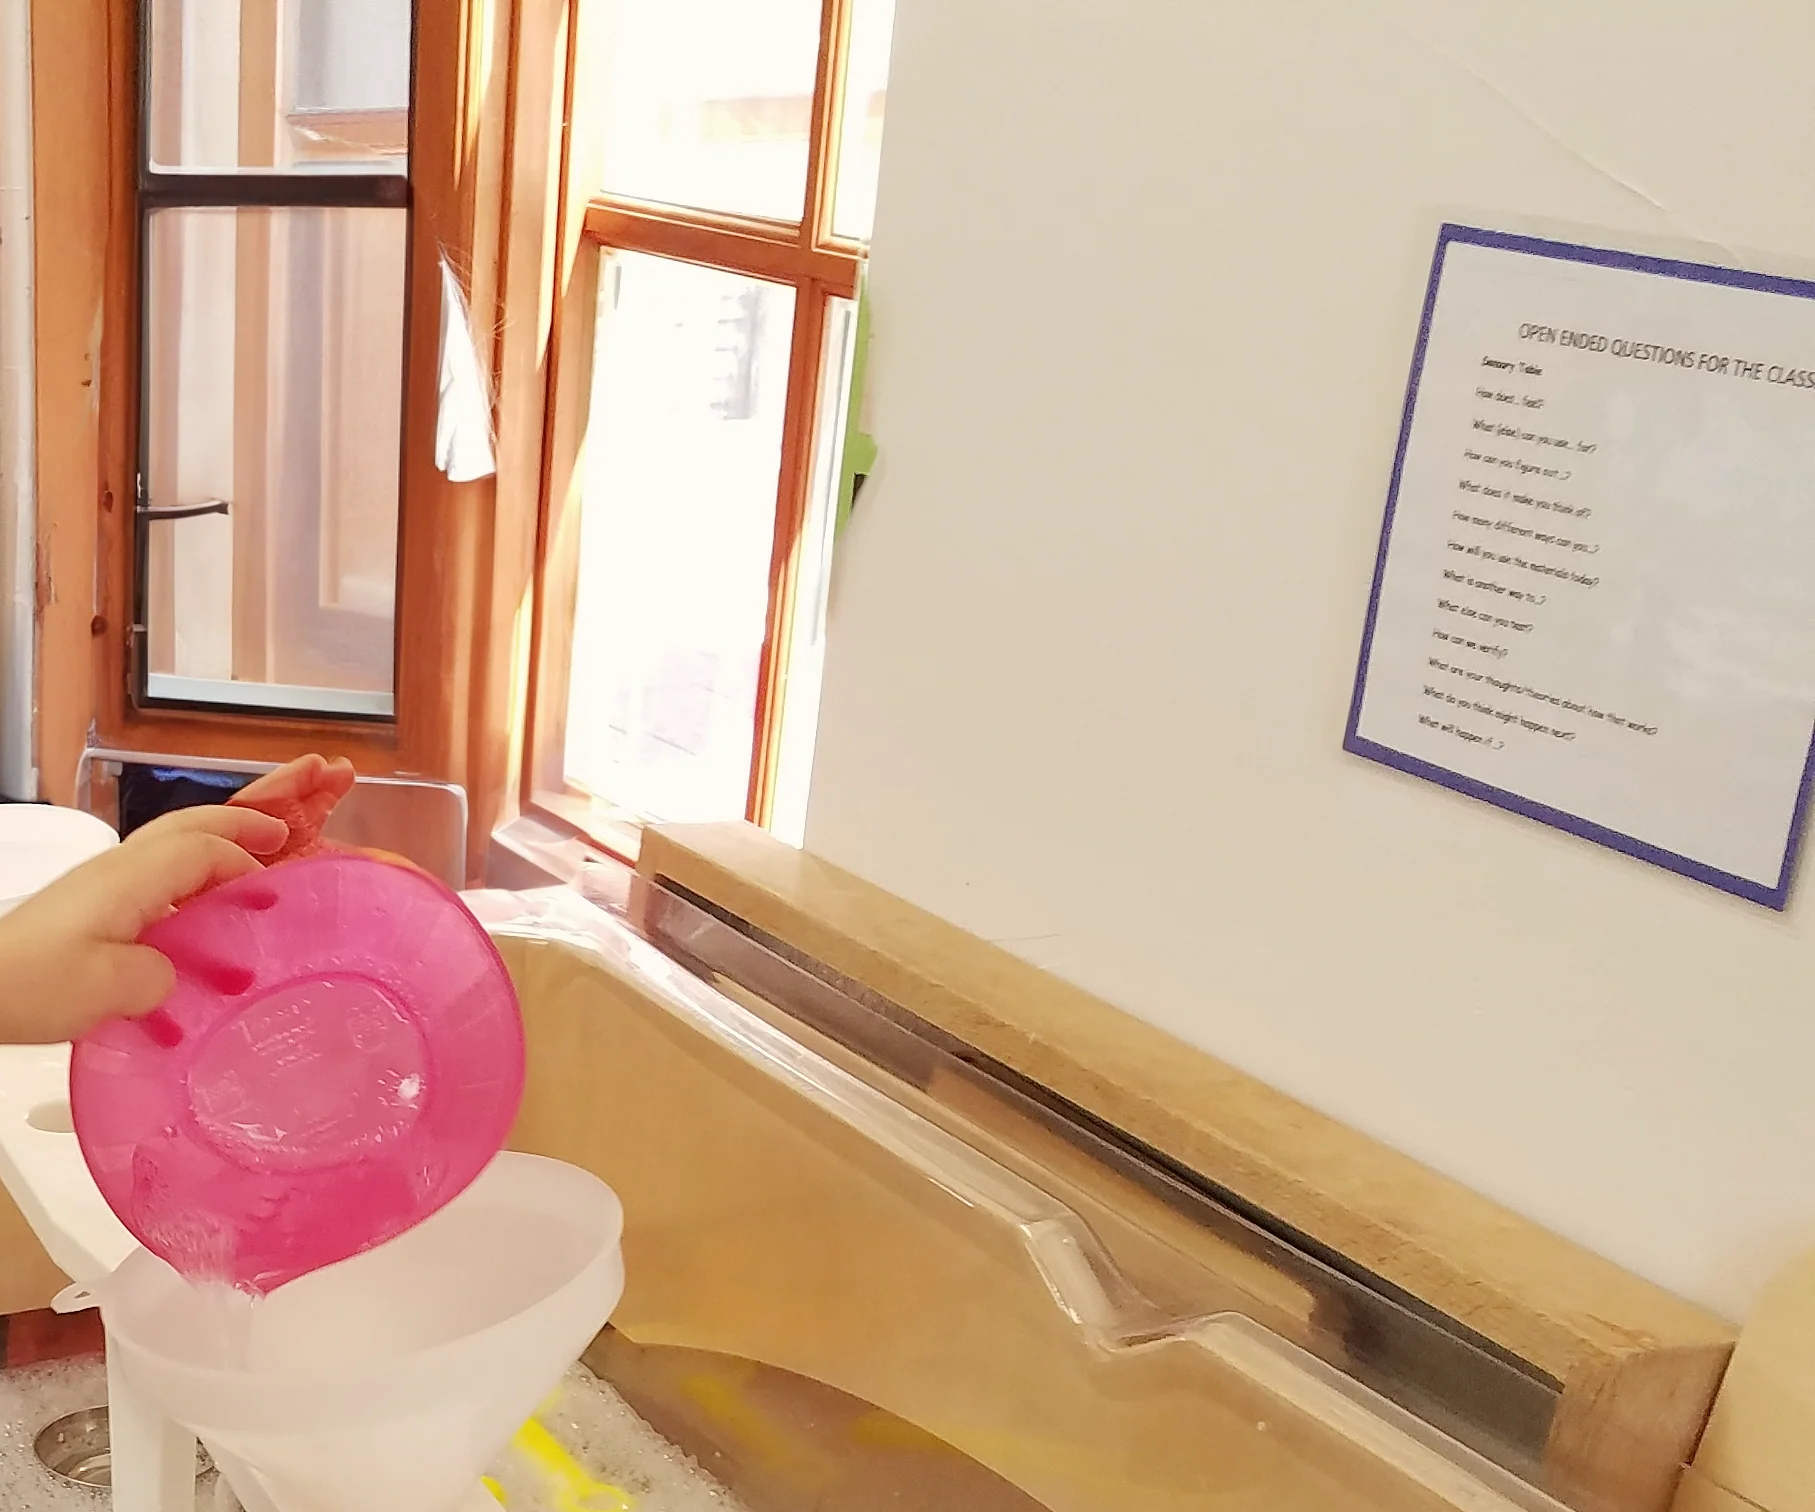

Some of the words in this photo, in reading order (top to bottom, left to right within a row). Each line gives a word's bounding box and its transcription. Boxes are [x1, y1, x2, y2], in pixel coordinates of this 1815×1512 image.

[1519, 323, 1559, 344] OPEN
[1559, 330, 1609, 352] ENDED
[1611, 339, 1695, 368] QUESTIONS
[1698, 353, 1729, 375] FOR
[1733, 358, 1765, 380] THE
[1767, 365, 1815, 388] CLASS
